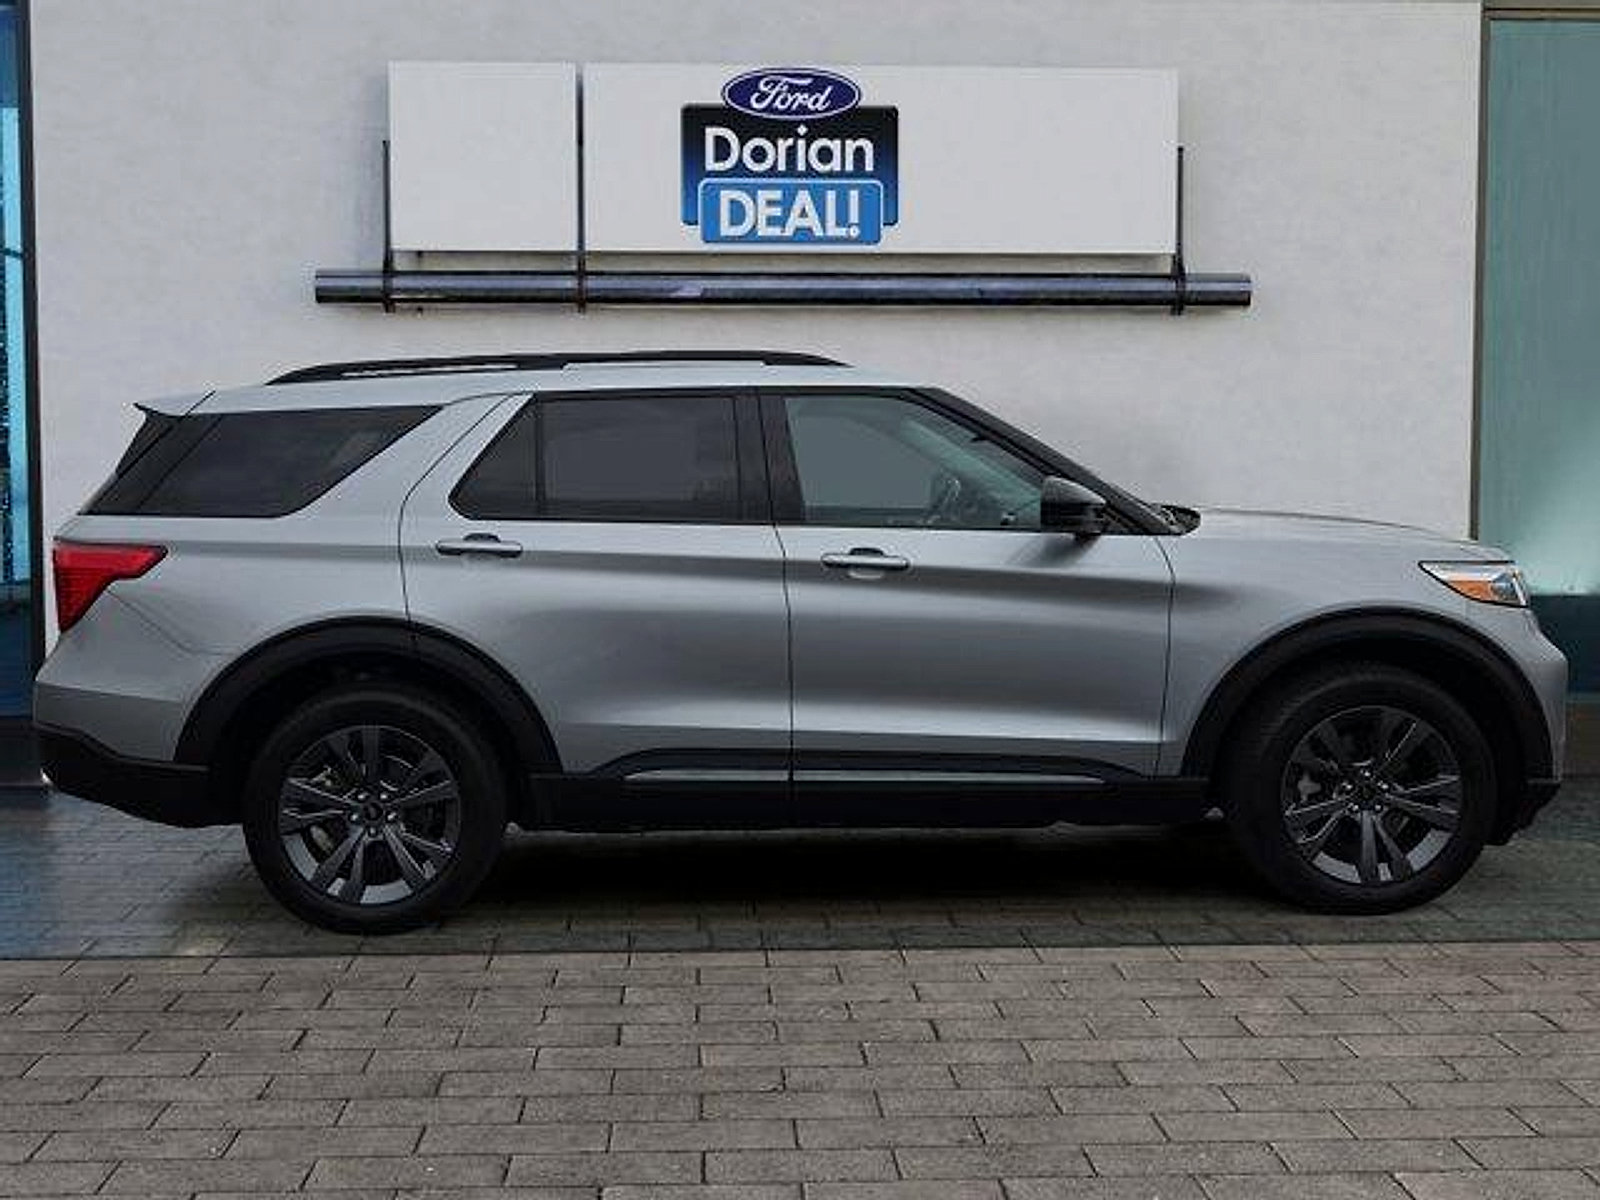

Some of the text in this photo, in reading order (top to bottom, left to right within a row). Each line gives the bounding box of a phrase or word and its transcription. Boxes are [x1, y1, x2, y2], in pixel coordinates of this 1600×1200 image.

[750, 76, 834, 111] Ford
[704, 124, 874, 172] Dorian
[719, 190, 860, 237] DEAL!
